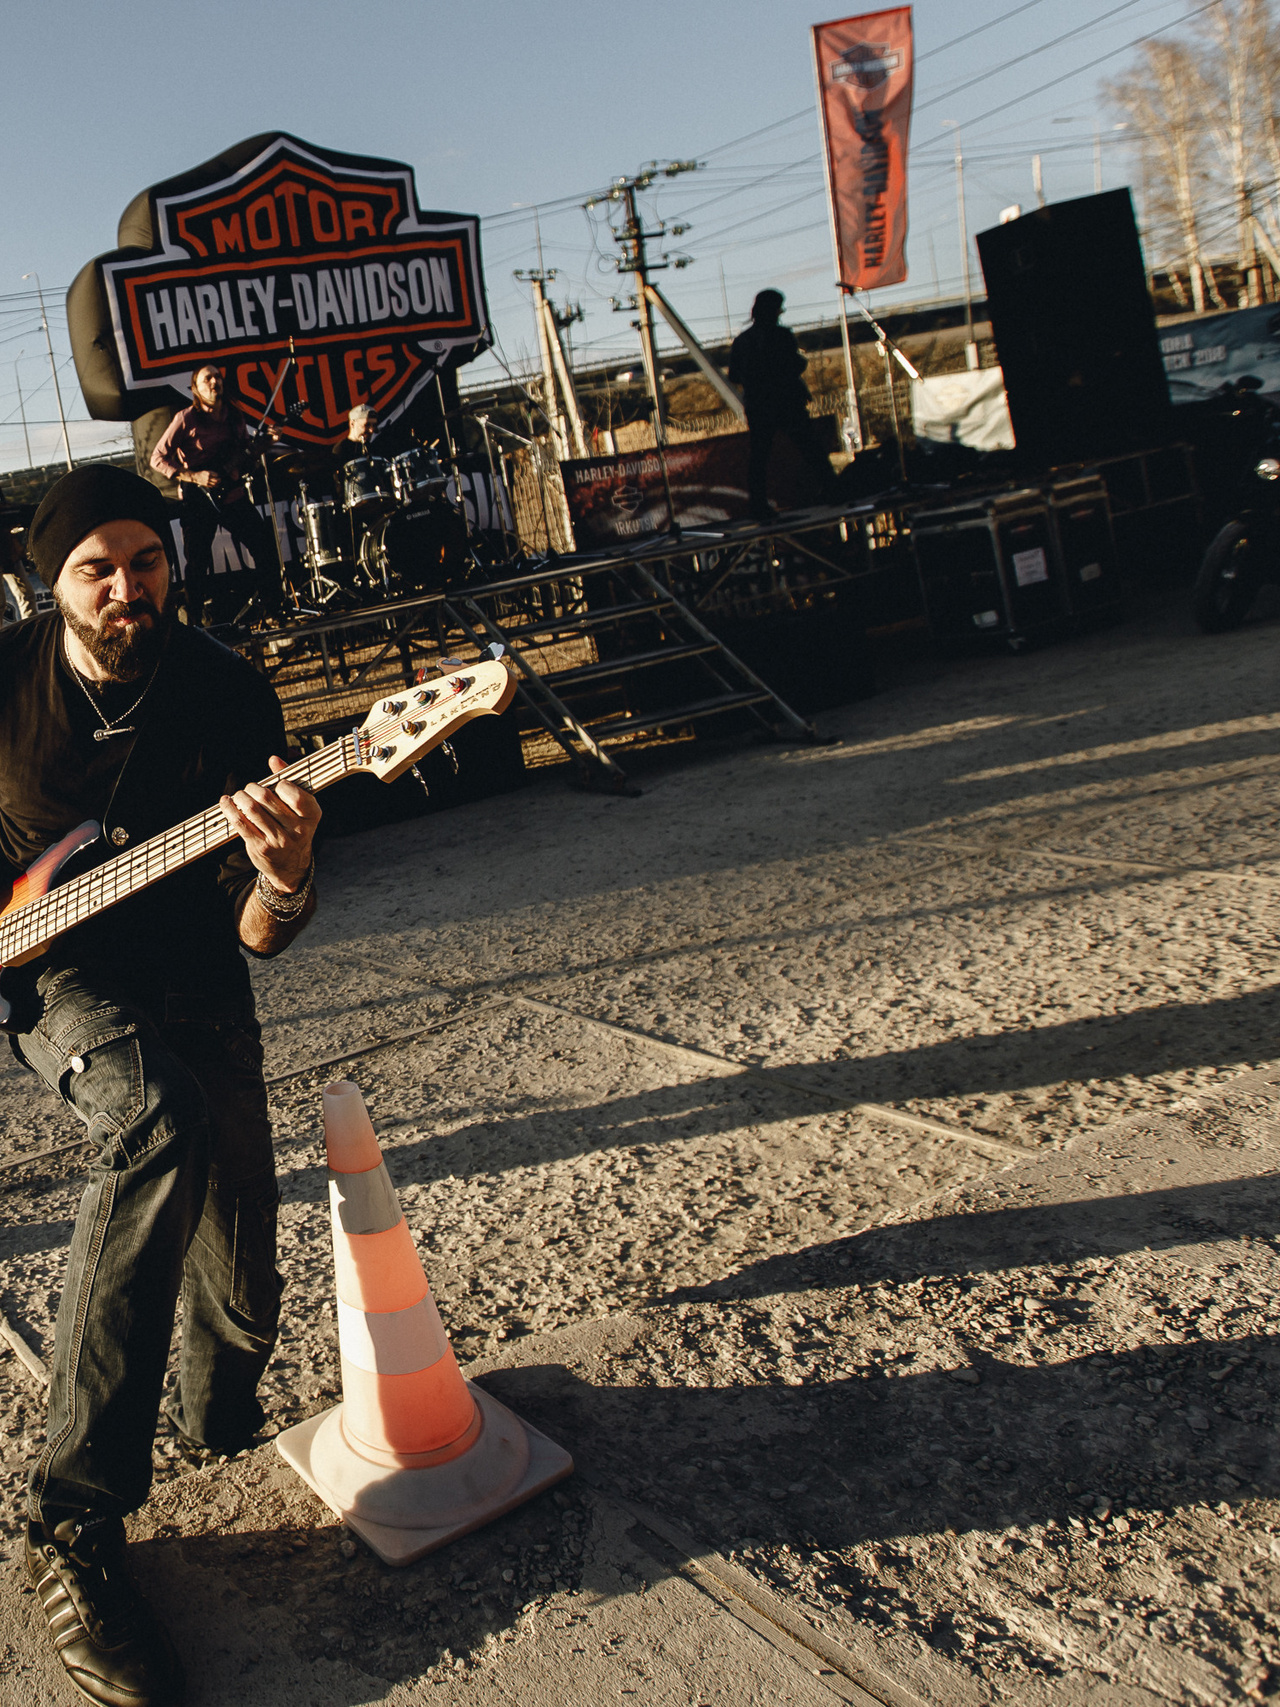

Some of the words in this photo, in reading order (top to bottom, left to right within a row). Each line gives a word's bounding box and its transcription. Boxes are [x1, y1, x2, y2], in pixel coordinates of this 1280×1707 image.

[211, 180, 377, 254] MOTOR
[145, 257, 455, 351] HARLEY-DAVIDSON
[236, 344, 397, 430] CYCLES
[431, 682, 501, 727] LAKLAND
